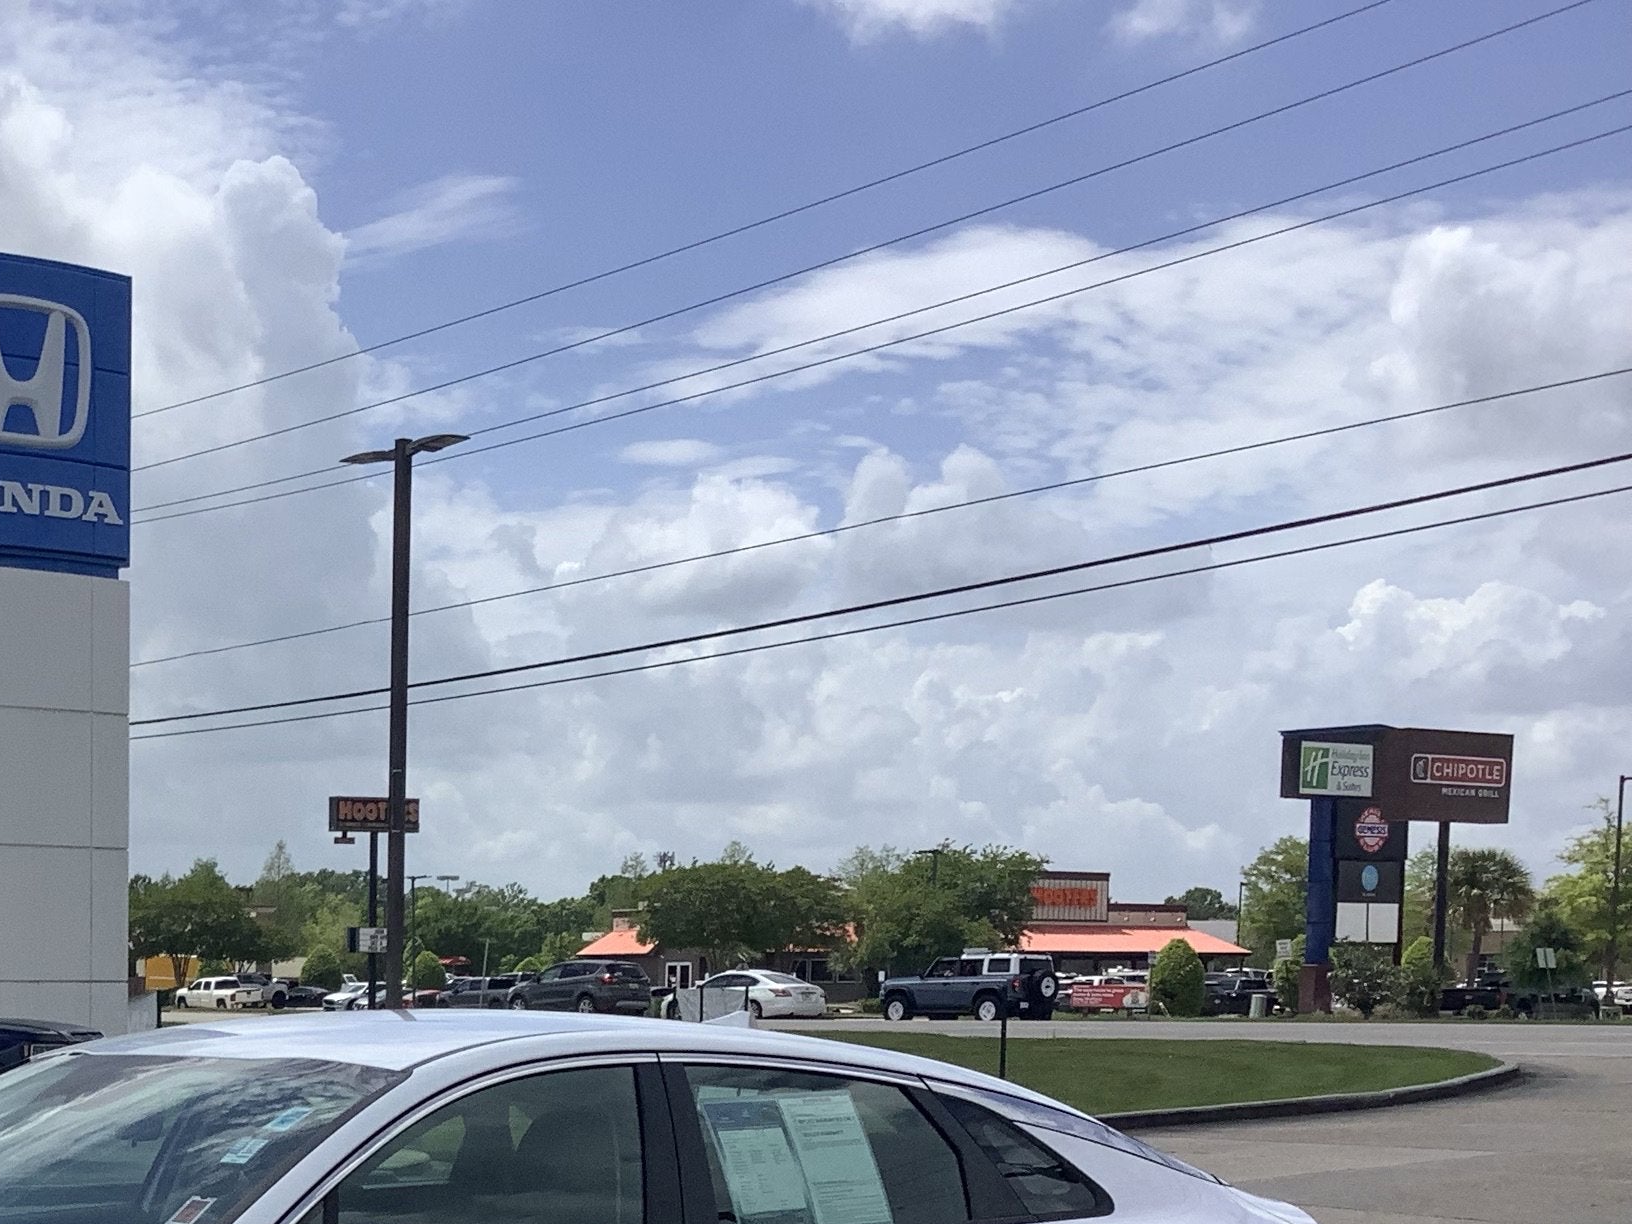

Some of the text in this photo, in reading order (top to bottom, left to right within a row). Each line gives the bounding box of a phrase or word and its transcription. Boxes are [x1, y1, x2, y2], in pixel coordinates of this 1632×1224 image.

[1331, 760, 1369, 780] Express
[1433, 762, 1502, 780] CHIPOTLE
[1441, 787, 1499, 798] MEXICAN GRILL
[338, 800, 418, 822] HOOTS
